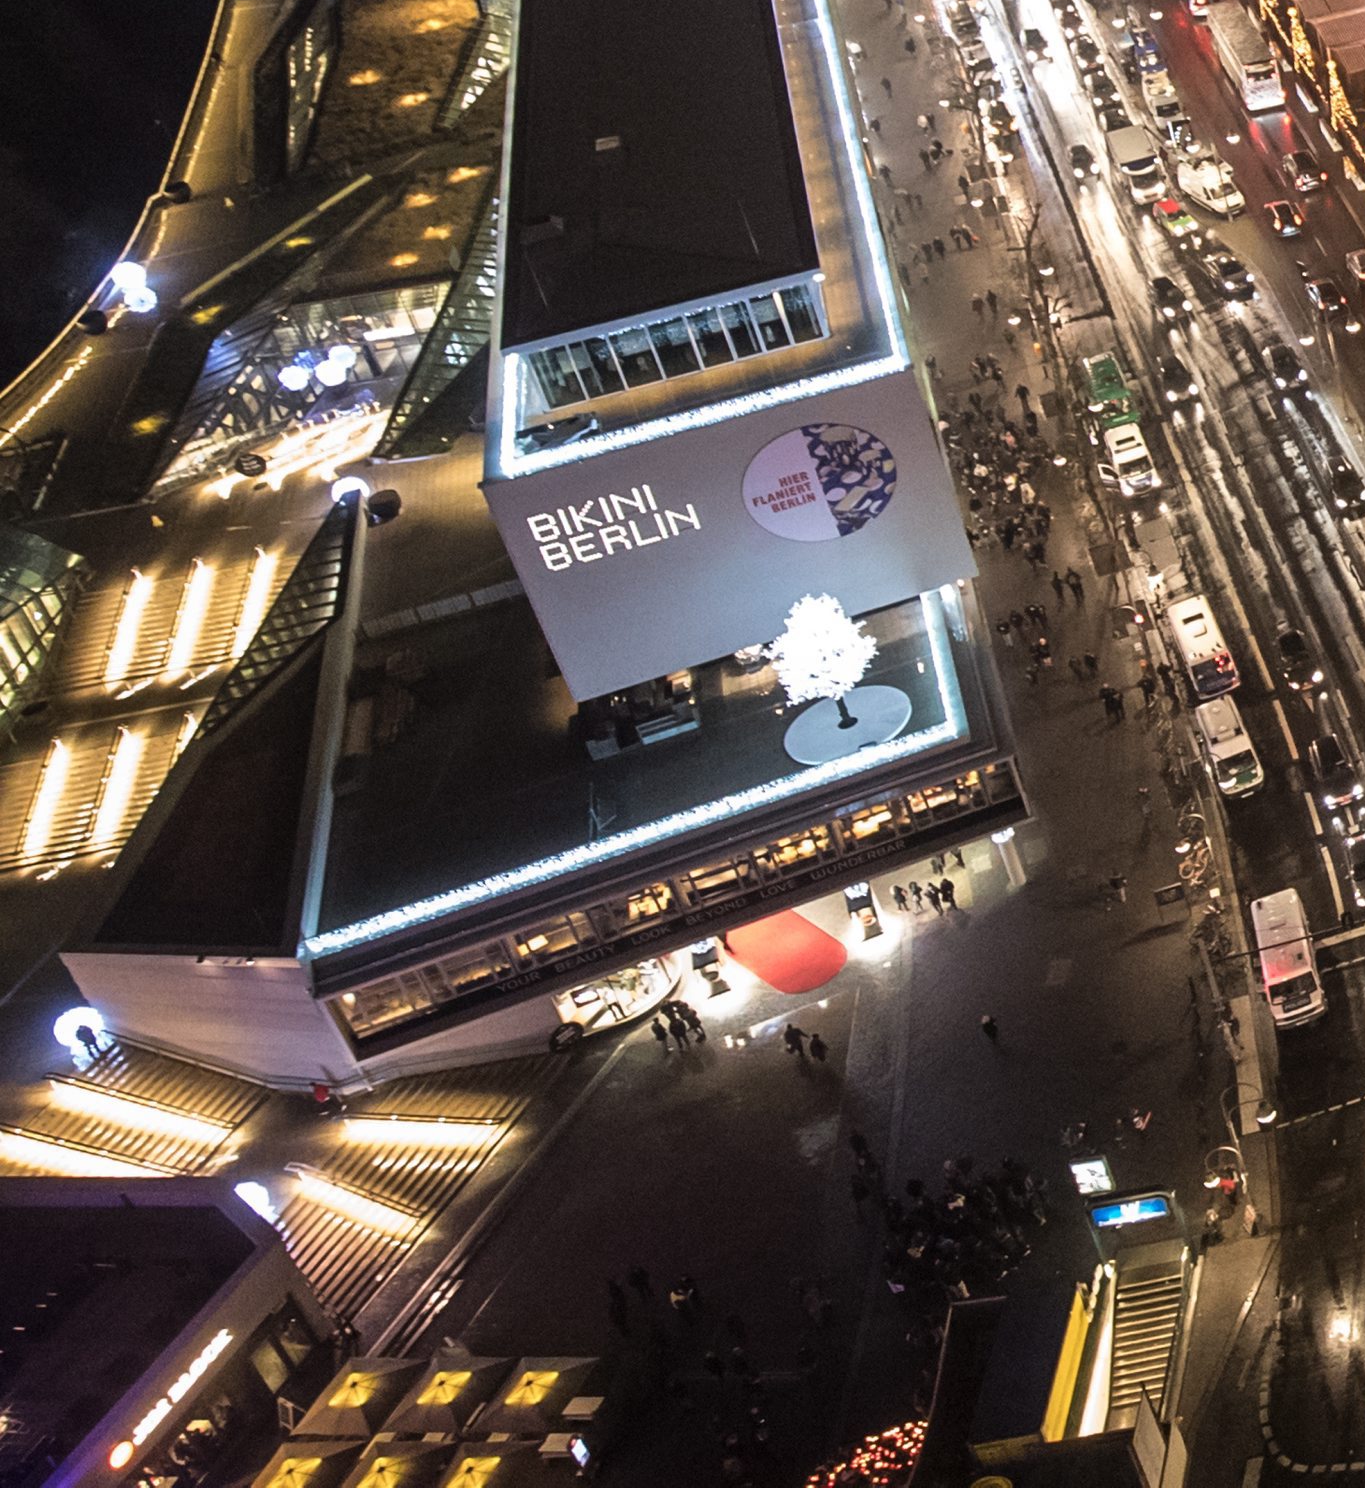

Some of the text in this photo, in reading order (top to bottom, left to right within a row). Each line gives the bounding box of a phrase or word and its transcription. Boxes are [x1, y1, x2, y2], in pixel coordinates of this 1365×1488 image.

[752, 481, 814, 509] FLANIERT
[778, 471, 811, 489] HIER
[526, 483, 659, 544] BIKINI
[770, 492, 817, 514] BERLIN
[538, 503, 702, 572] BERLIN
[497, 839, 907, 994] YOUR BEAUTY LOOK BEYOND LOVE WUNDERBAR
